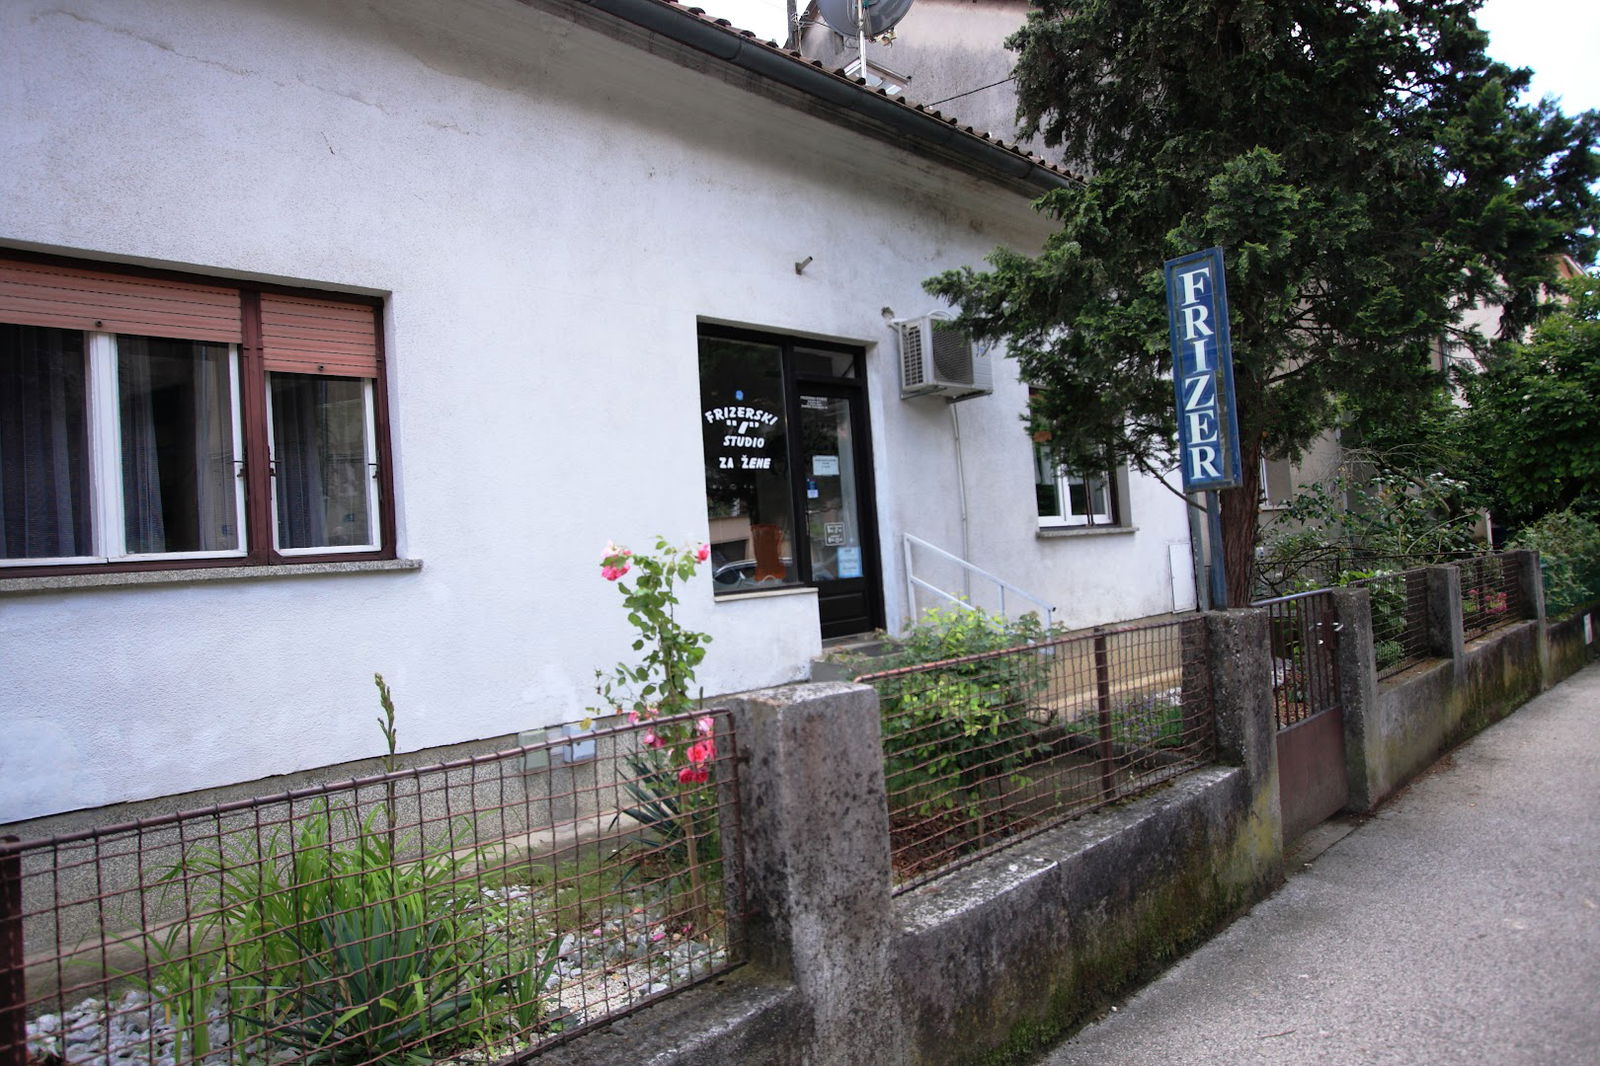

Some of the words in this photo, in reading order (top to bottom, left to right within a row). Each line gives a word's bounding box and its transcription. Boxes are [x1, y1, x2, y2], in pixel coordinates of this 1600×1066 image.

[1179, 267, 1221, 480] FRIZER
[705, 407, 778, 425] FRIZERSKI
[723, 436, 765, 448] STUDIO
[719, 457, 734, 469] ZA
[741, 455, 771, 469] ŽENE
